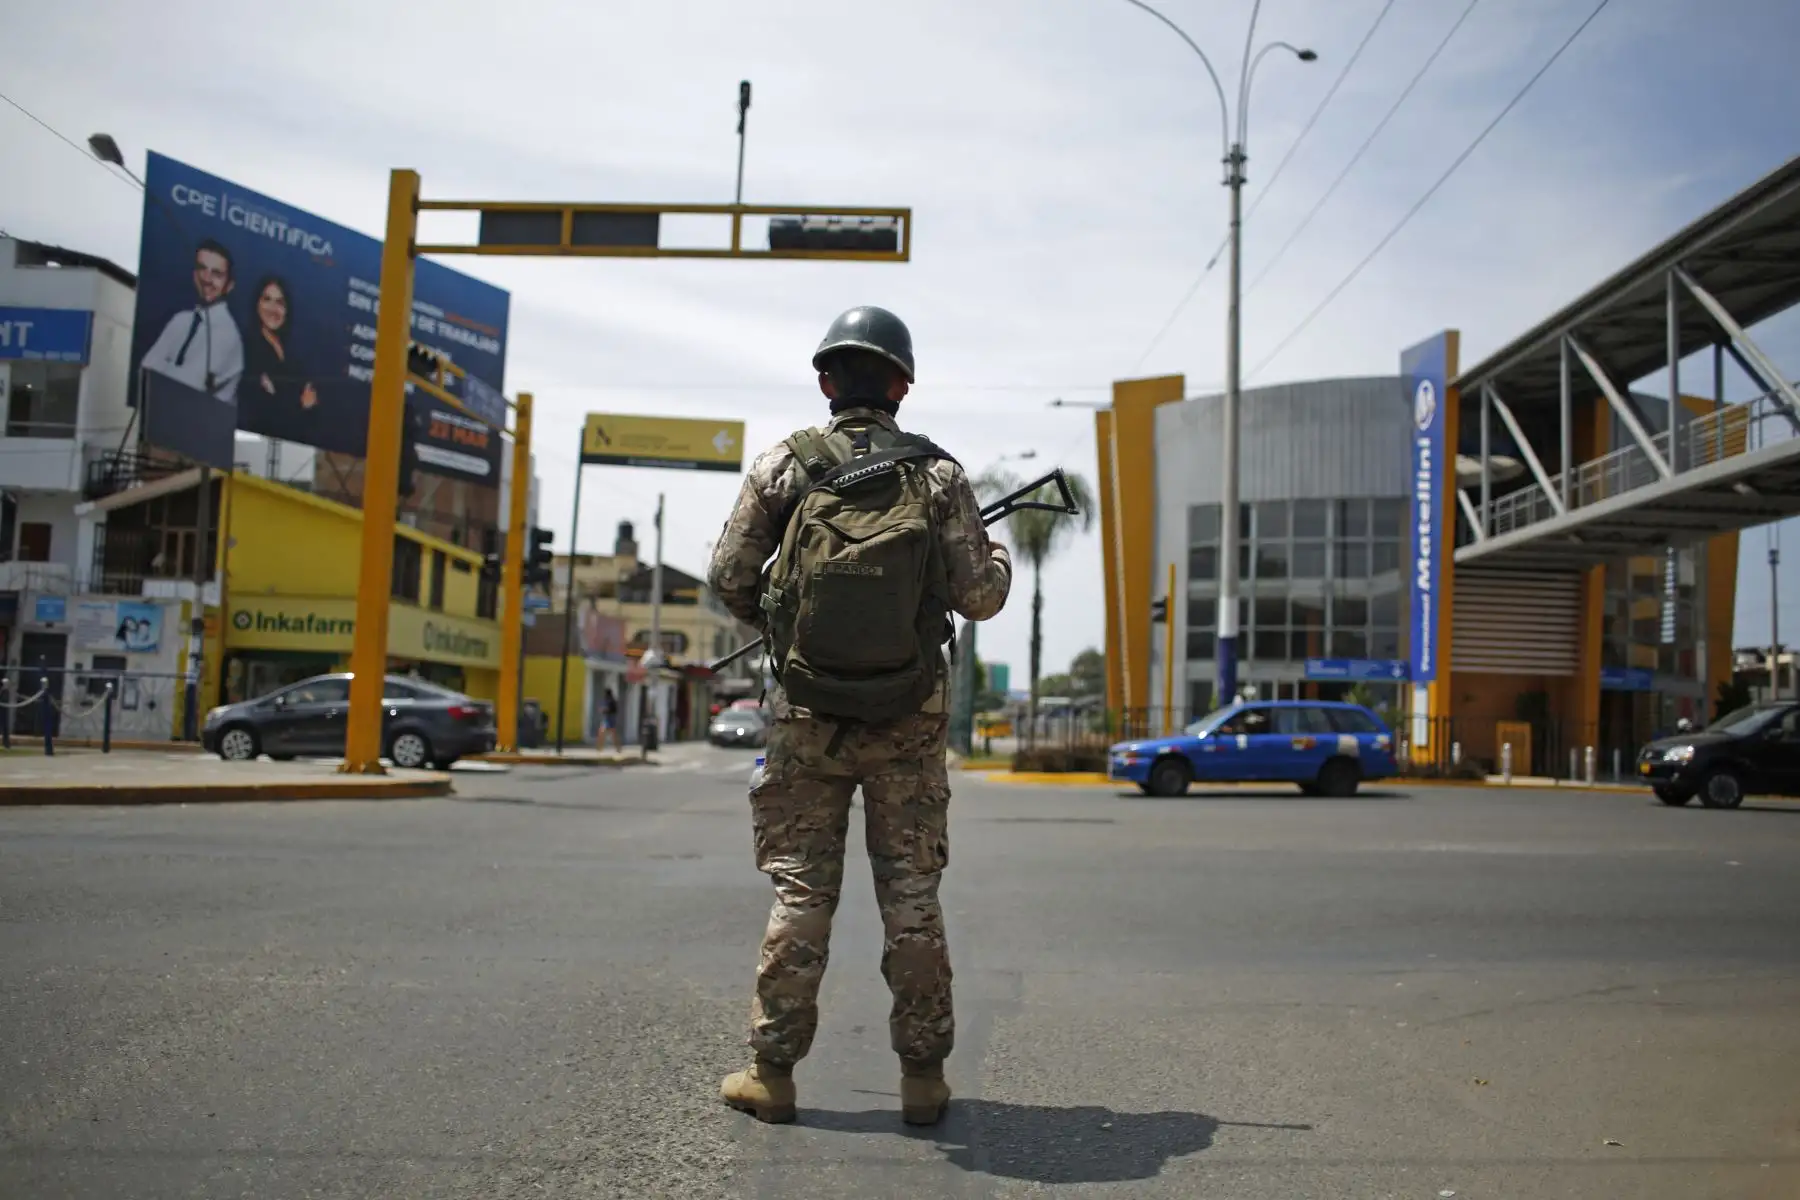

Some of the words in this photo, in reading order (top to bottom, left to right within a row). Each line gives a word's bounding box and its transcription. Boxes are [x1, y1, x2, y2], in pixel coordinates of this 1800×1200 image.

[172, 184, 217, 216] CPE
[1417, 437, 1432, 590] Matellini
[256, 610, 355, 634] Inkafarm
